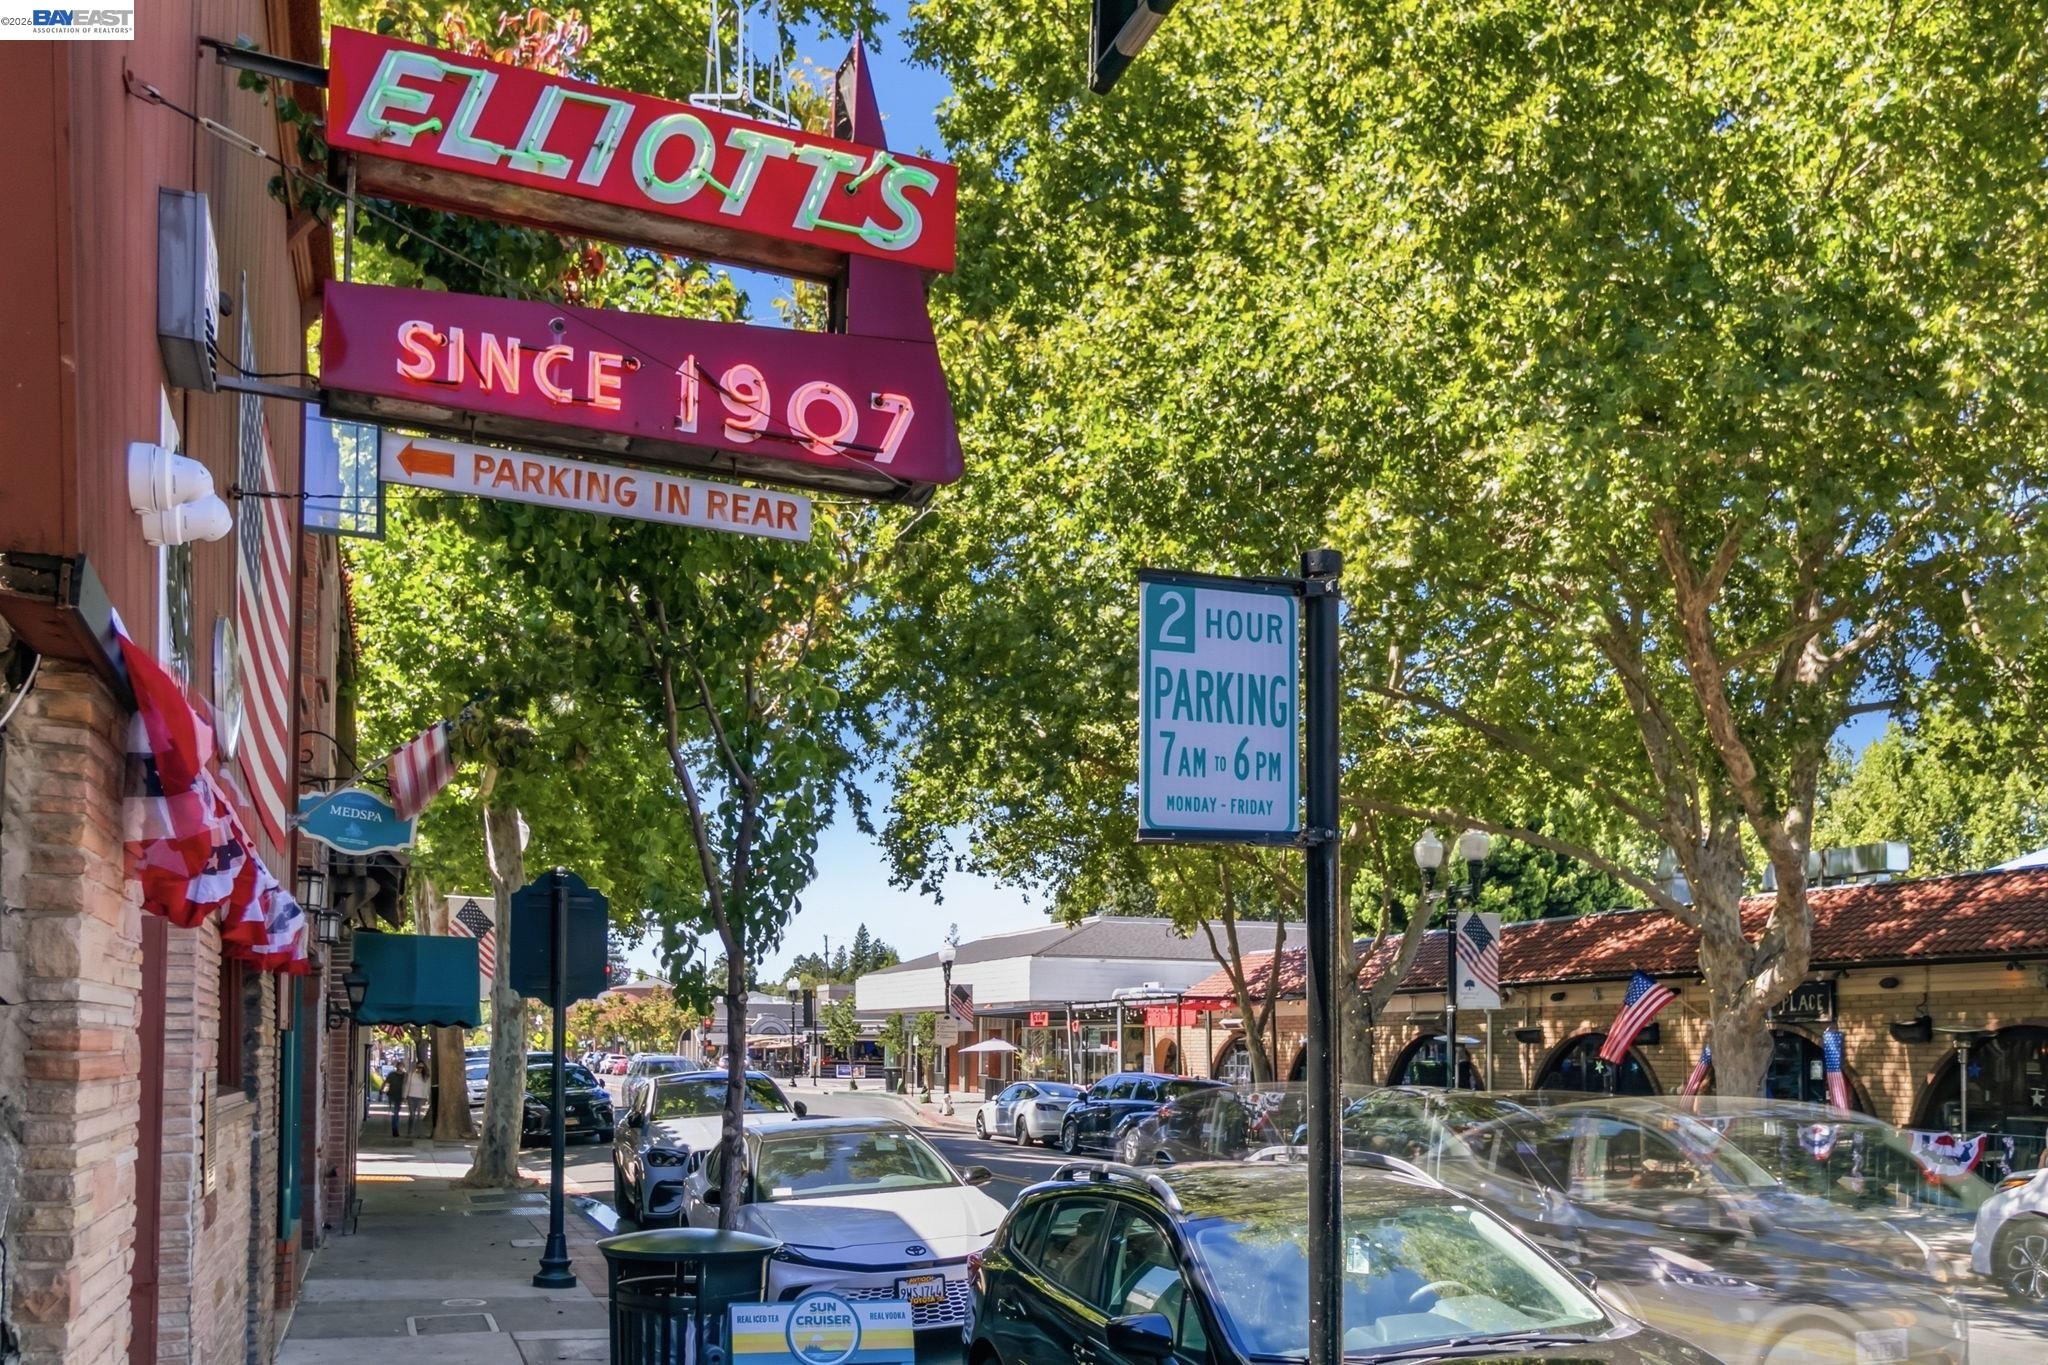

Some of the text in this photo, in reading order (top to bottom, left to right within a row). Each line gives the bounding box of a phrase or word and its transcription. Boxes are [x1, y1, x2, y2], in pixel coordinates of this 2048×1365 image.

[347, 50, 940, 251] ELLIOTT'S
[396, 319, 915, 463] SINCE 1907
[473, 453, 799, 531] PARKING IN REAR
[1158, 590, 1283, 645] 2 HOUR
[1154, 666, 1288, 728] PARKING
[1214, 755, 1227, 772] TO
[329, 804, 383, 823] MEDSPA
[1166, 795, 1217, 813] MONDAY
[1230, 798, 1274, 816] FRIDAY
[1781, 994, 1825, 1012] PLACE
[809, 1302, 837, 1313] SUN
[869, 1311, 906, 1320] REAL VODKA
[736, 1314, 780, 1324] REAL ICED TEA
[795, 1315, 851, 1326] CRUISER
